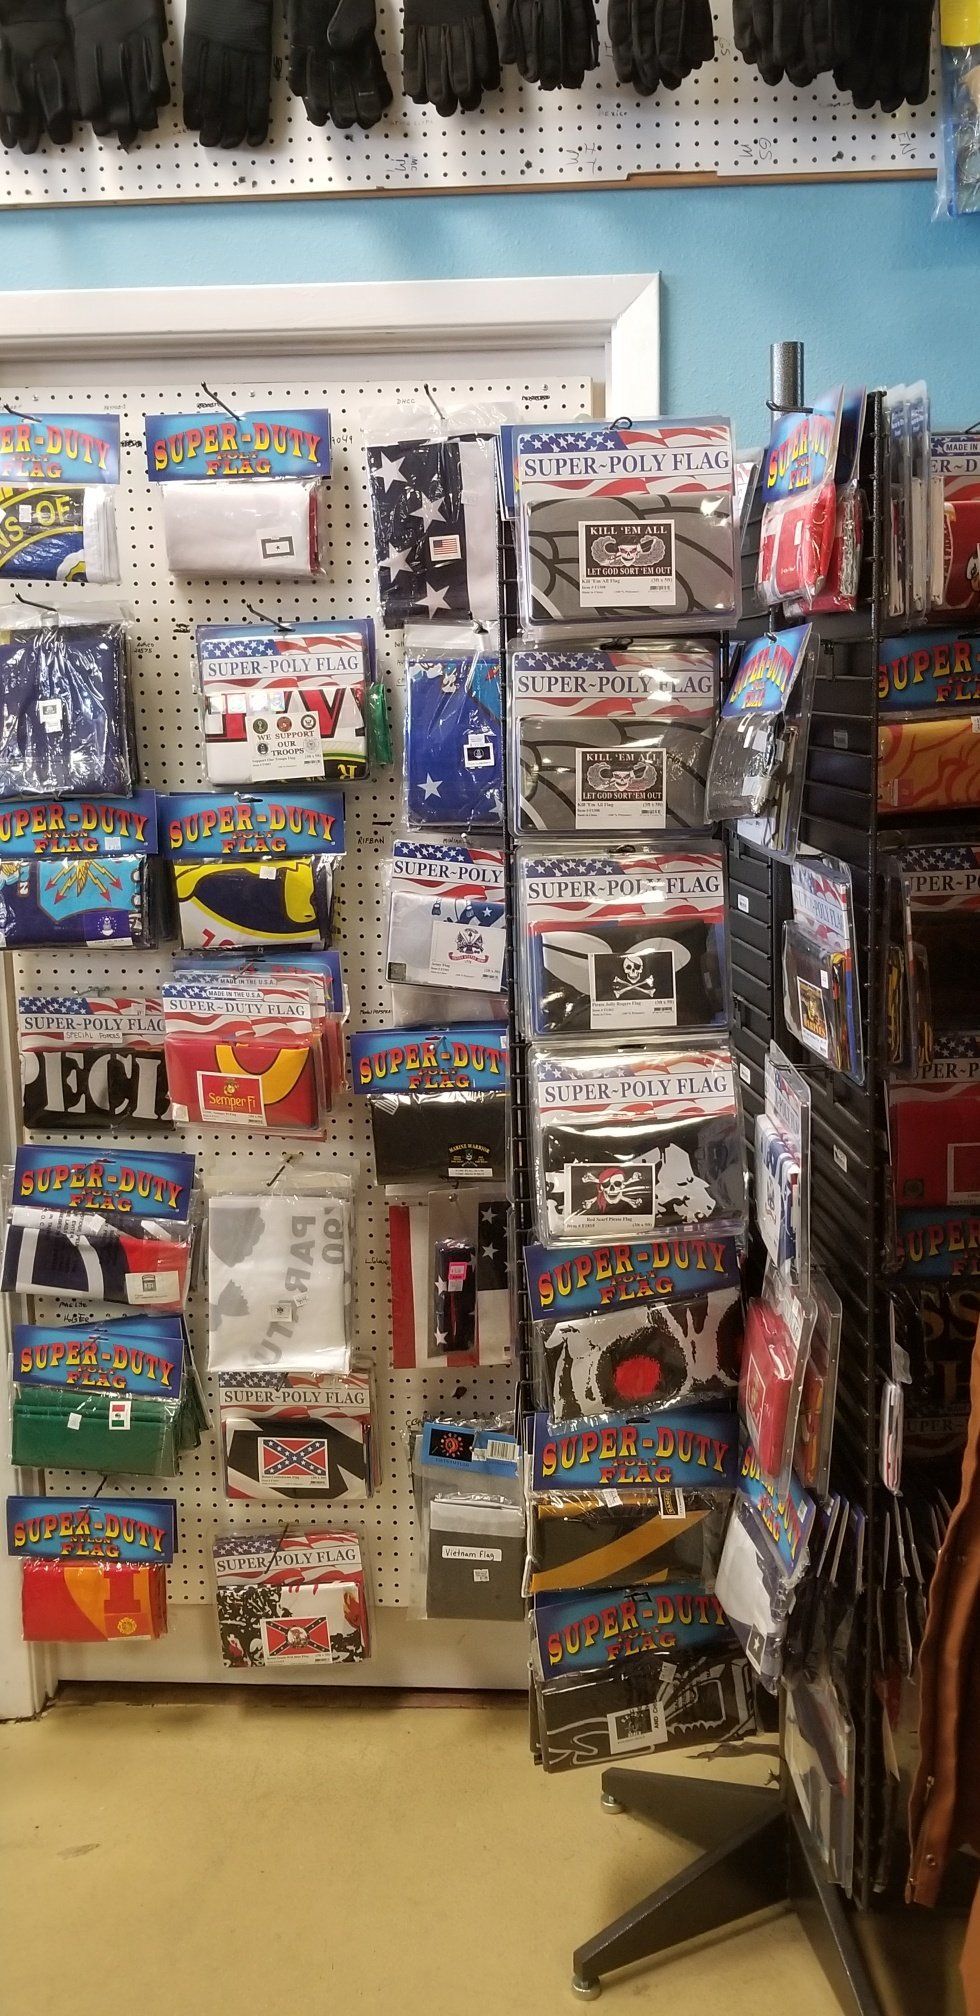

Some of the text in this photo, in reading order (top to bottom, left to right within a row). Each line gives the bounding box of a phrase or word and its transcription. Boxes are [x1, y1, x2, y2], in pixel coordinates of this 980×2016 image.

[154, 422, 321, 471] SUPER-DUTY
[946, 443, 968, 451] MADE
[205, 457, 272, 476] FLAG
[524, 450, 730, 477] SUPER~POLY FLAG
[36, 496, 70, 527] OF
[590, 526, 618, 535] KILL
[645, 525, 668, 534] ALL
[587, 568, 602, 576] LET
[602, 567, 619, 576] GOD
[620, 567, 640, 575] SORT
[655, 566, 672, 574] OUT
[316, 655, 359, 671] FLAG
[518, 676, 713, 693] SUPER~POLY FLAG
[275, 731, 315, 740] SUPPORT
[271, 748, 305, 757] TROOPS
[586, 754, 612, 762] KILL
[638, 754, 659, 762] ALL
[168, 804, 336, 850] SUPER-DUTY
[33, 836, 99, 854] FLAG
[221, 838, 287, 854] FLAG
[394, 860, 503, 884] SUPER~POLY
[666, 875, 721, 893] FLAG
[169, 1000, 305, 1016] SUPER~DUTY FLAG
[24, 1016, 166, 1031] SUPER~POLY FLAG
[409, 1075, 471, 1089] FLAG
[545, 1076, 728, 1103] SUPER~POLY FLAG
[208, 1092, 256, 1112] Semper Fi
[449, 1144, 467, 1153] MARINE
[20, 1163, 183, 1208] SUPER-DUTY
[68, 1194, 133, 1212] FLAG
[537, 1238, 727, 1307] SUPER-DUTY
[600, 1277, 674, 1305] FLAG
[20, 1341, 175, 1386] SUPER-DUTY
[66, 1371, 127, 1389] FLAG
[326, 1391, 366, 1404] FLAG
[542, 1425, 729, 1477] SUPER-DUTY
[599, 1466, 673, 1484] FLAG
[14, 1511, 166, 1552] SUPER-DUTY
[60, 1542, 121, 1558] FLAG
[317, 1548, 356, 1563] FLAG
[445, 1548, 495, 1561] Vietnam Flag
[547, 1594, 727, 1666] SUPER-DUTY
[607, 1631, 677, 1662] FLAG
